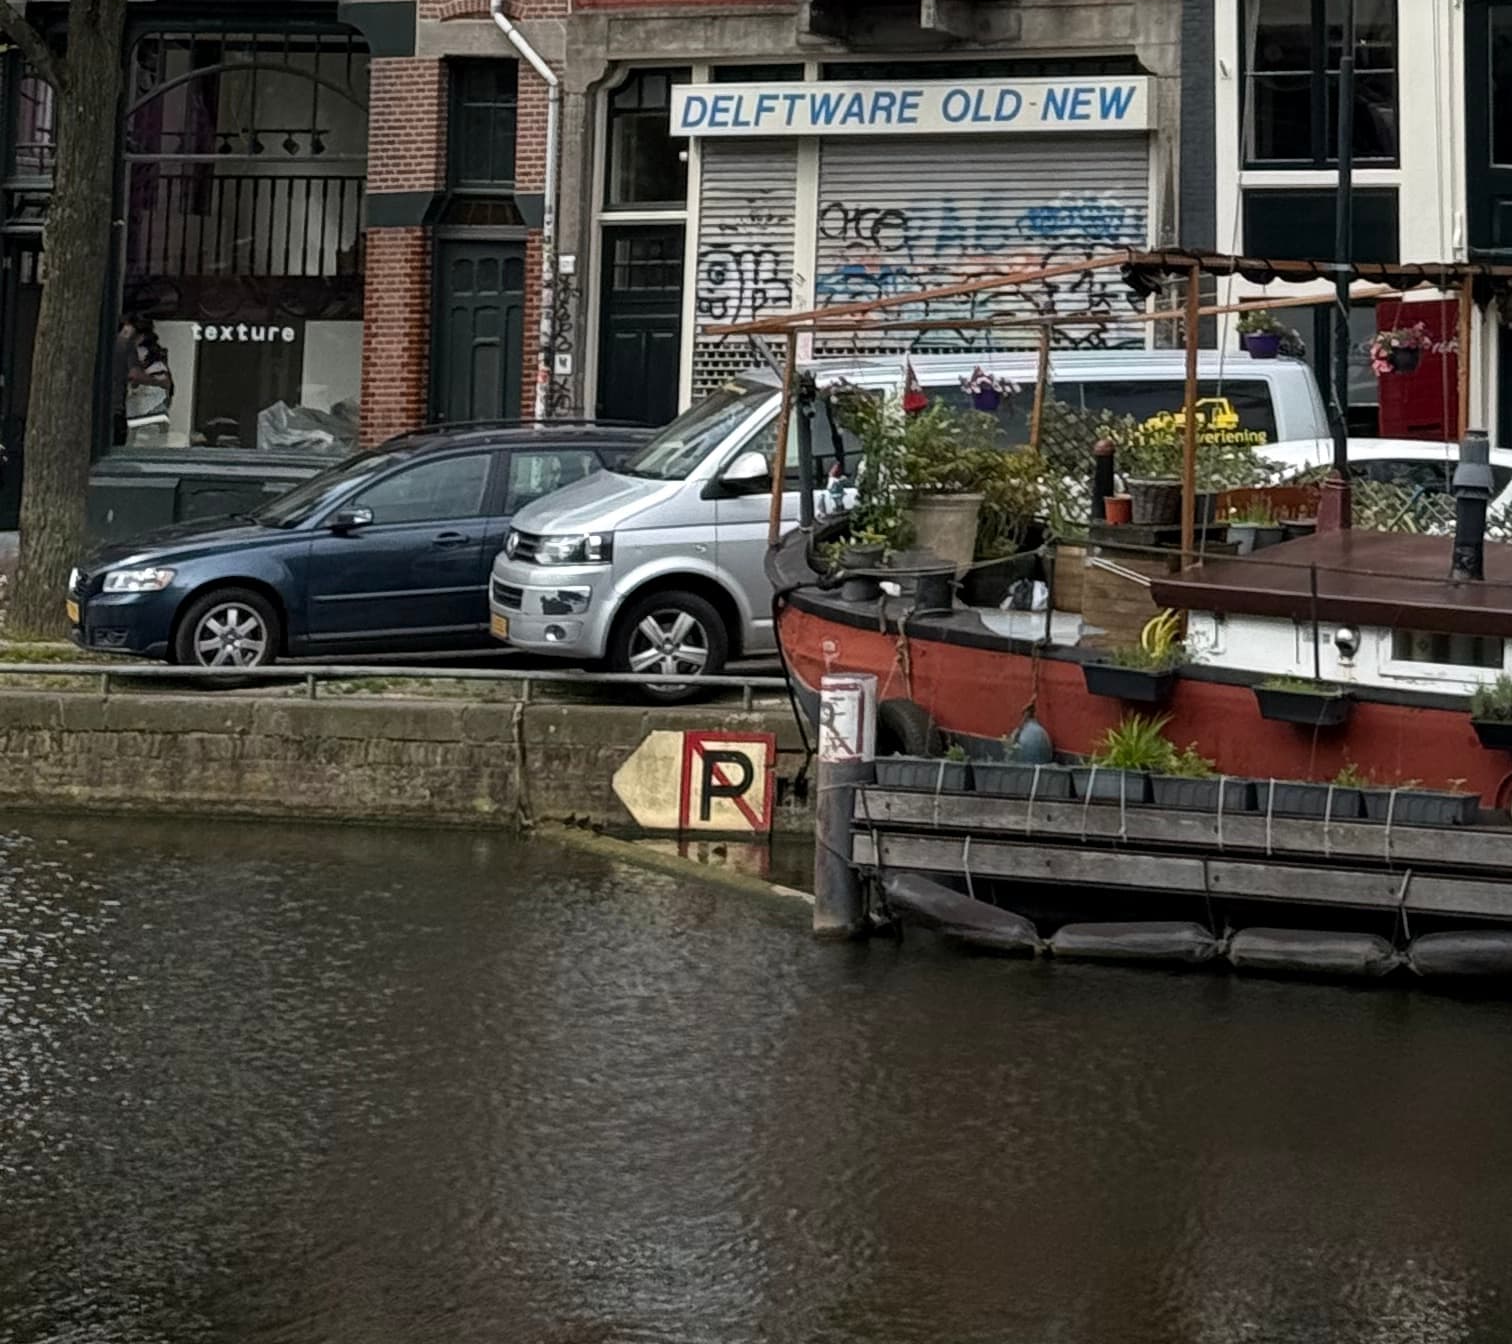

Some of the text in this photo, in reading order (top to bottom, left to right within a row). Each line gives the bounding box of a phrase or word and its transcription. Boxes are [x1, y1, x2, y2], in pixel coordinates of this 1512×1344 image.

[681, 90, 924, 128] DELFTWARE
[941, 88, 1022, 123] OLD
[1040, 85, 1137, 121] NEW
[191, 322, 295, 342] texture
